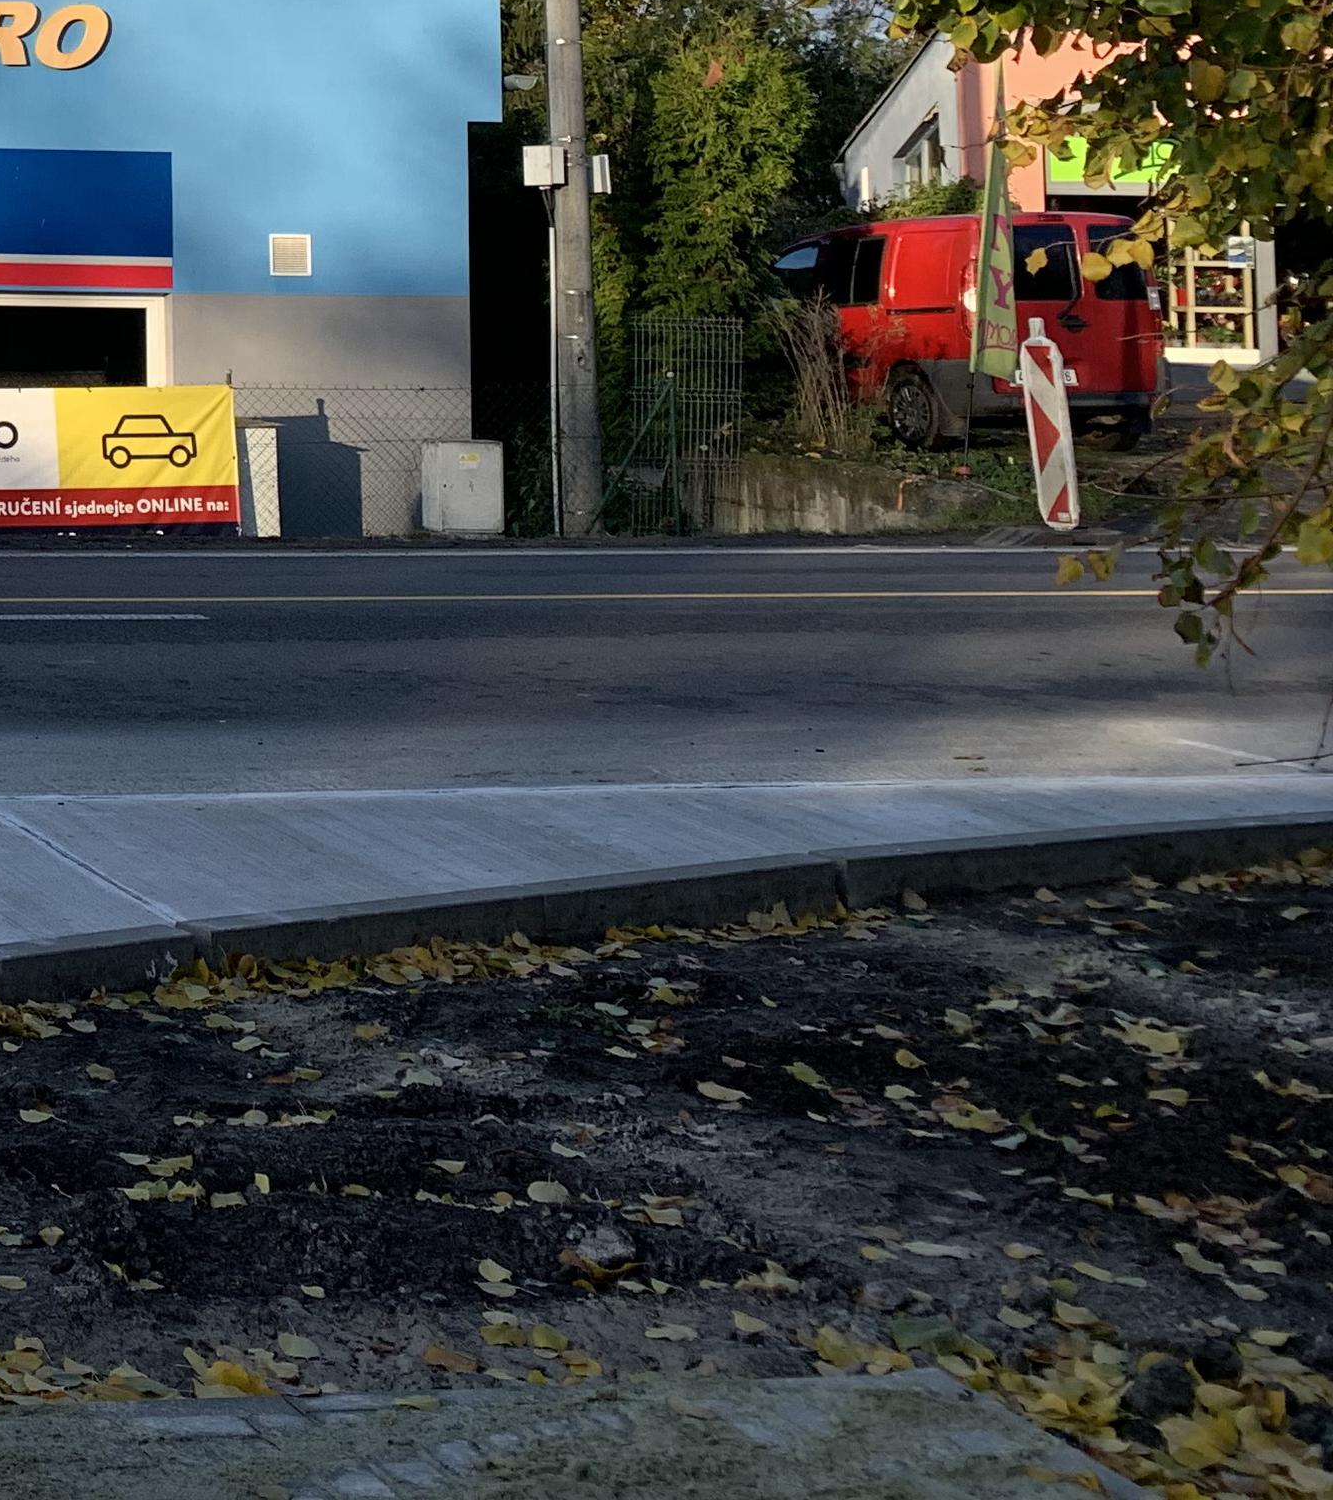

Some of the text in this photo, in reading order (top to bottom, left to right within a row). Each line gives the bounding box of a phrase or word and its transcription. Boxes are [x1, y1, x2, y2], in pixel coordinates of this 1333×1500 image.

[64, 500, 134, 518] sjednejte
[136, 497, 204, 513] ONLINE
[206, 500, 230, 512] na:
